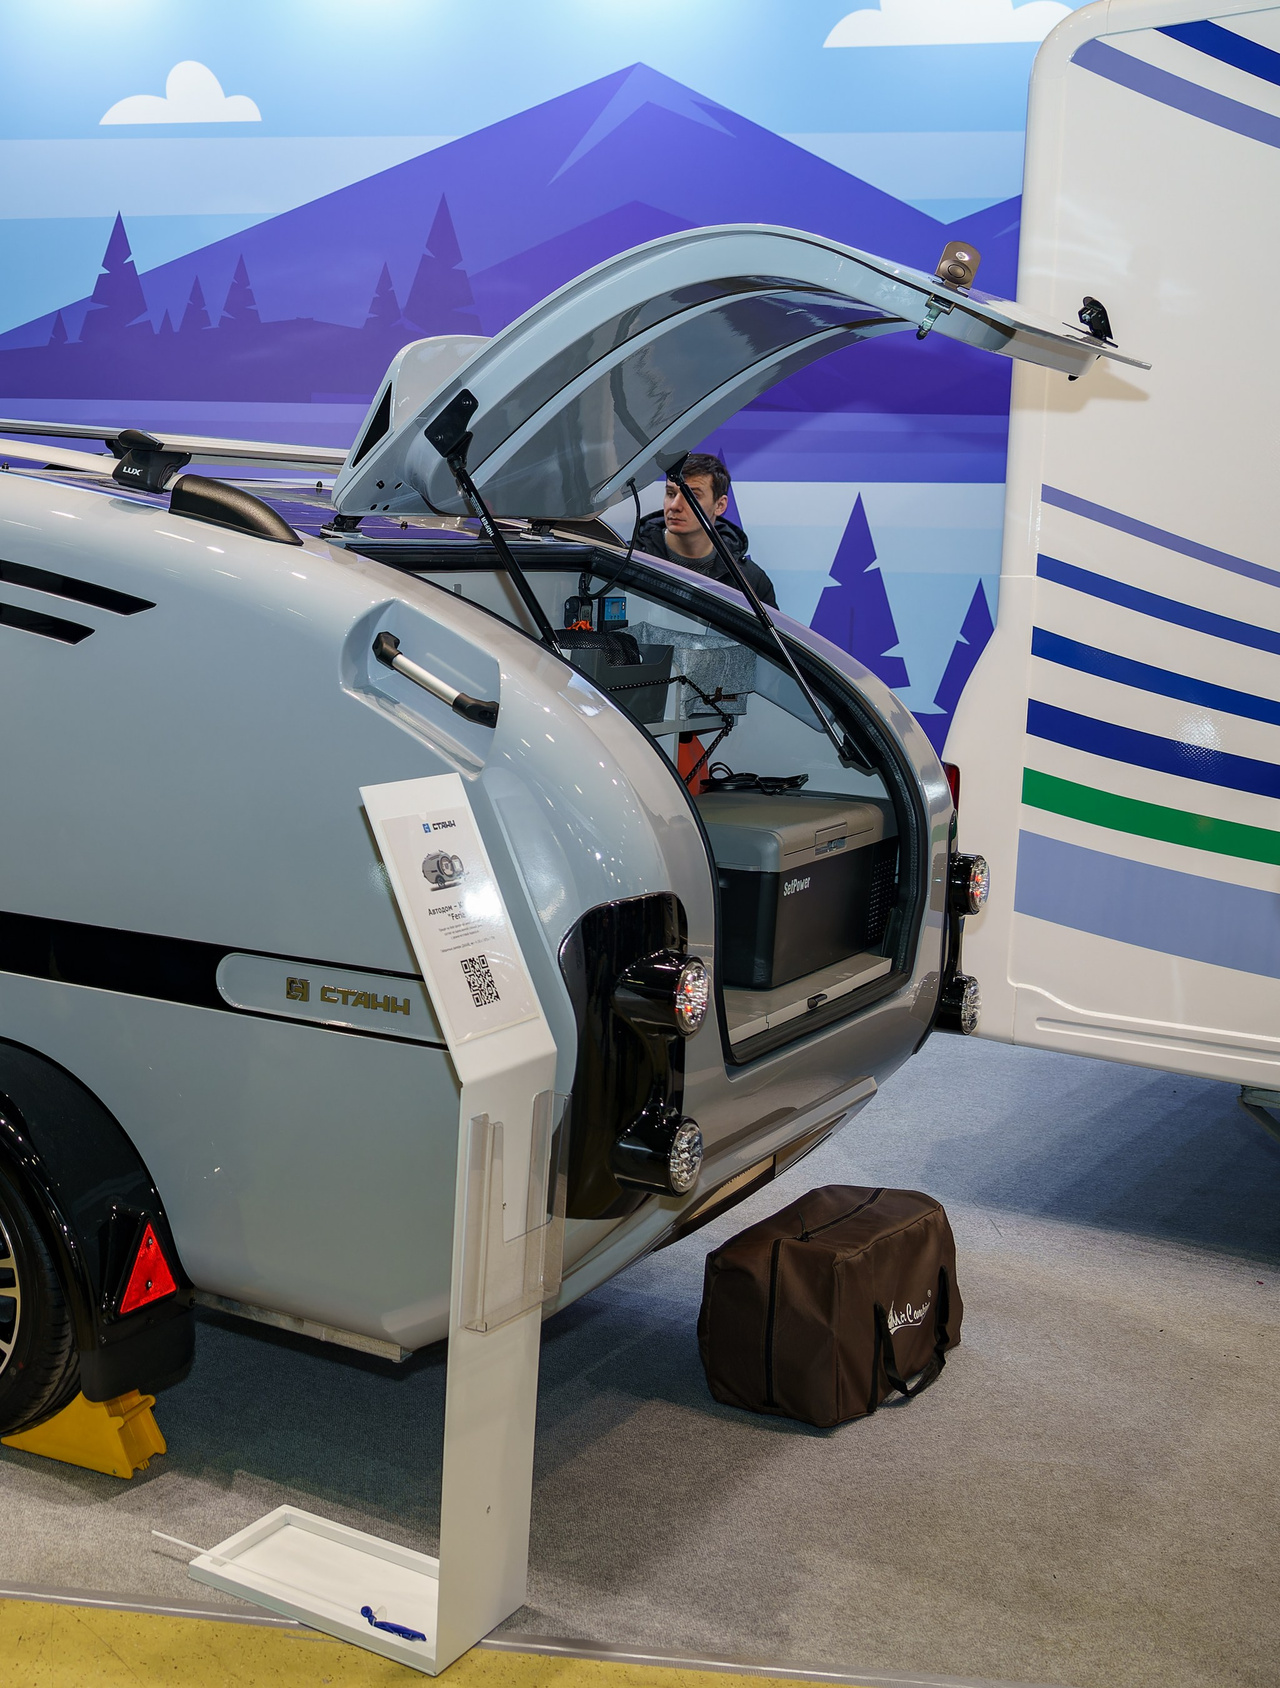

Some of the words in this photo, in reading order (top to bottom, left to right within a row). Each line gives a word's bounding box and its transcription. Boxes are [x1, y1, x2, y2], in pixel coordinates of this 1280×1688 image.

[122, 466, 141, 476] LUX
[432, 819, 457, 831] СТАНН
[783, 876, 811, 897] SetPower
[428, 904, 454, 916] Автодом
[320, 984, 411, 1016] СТАНН
